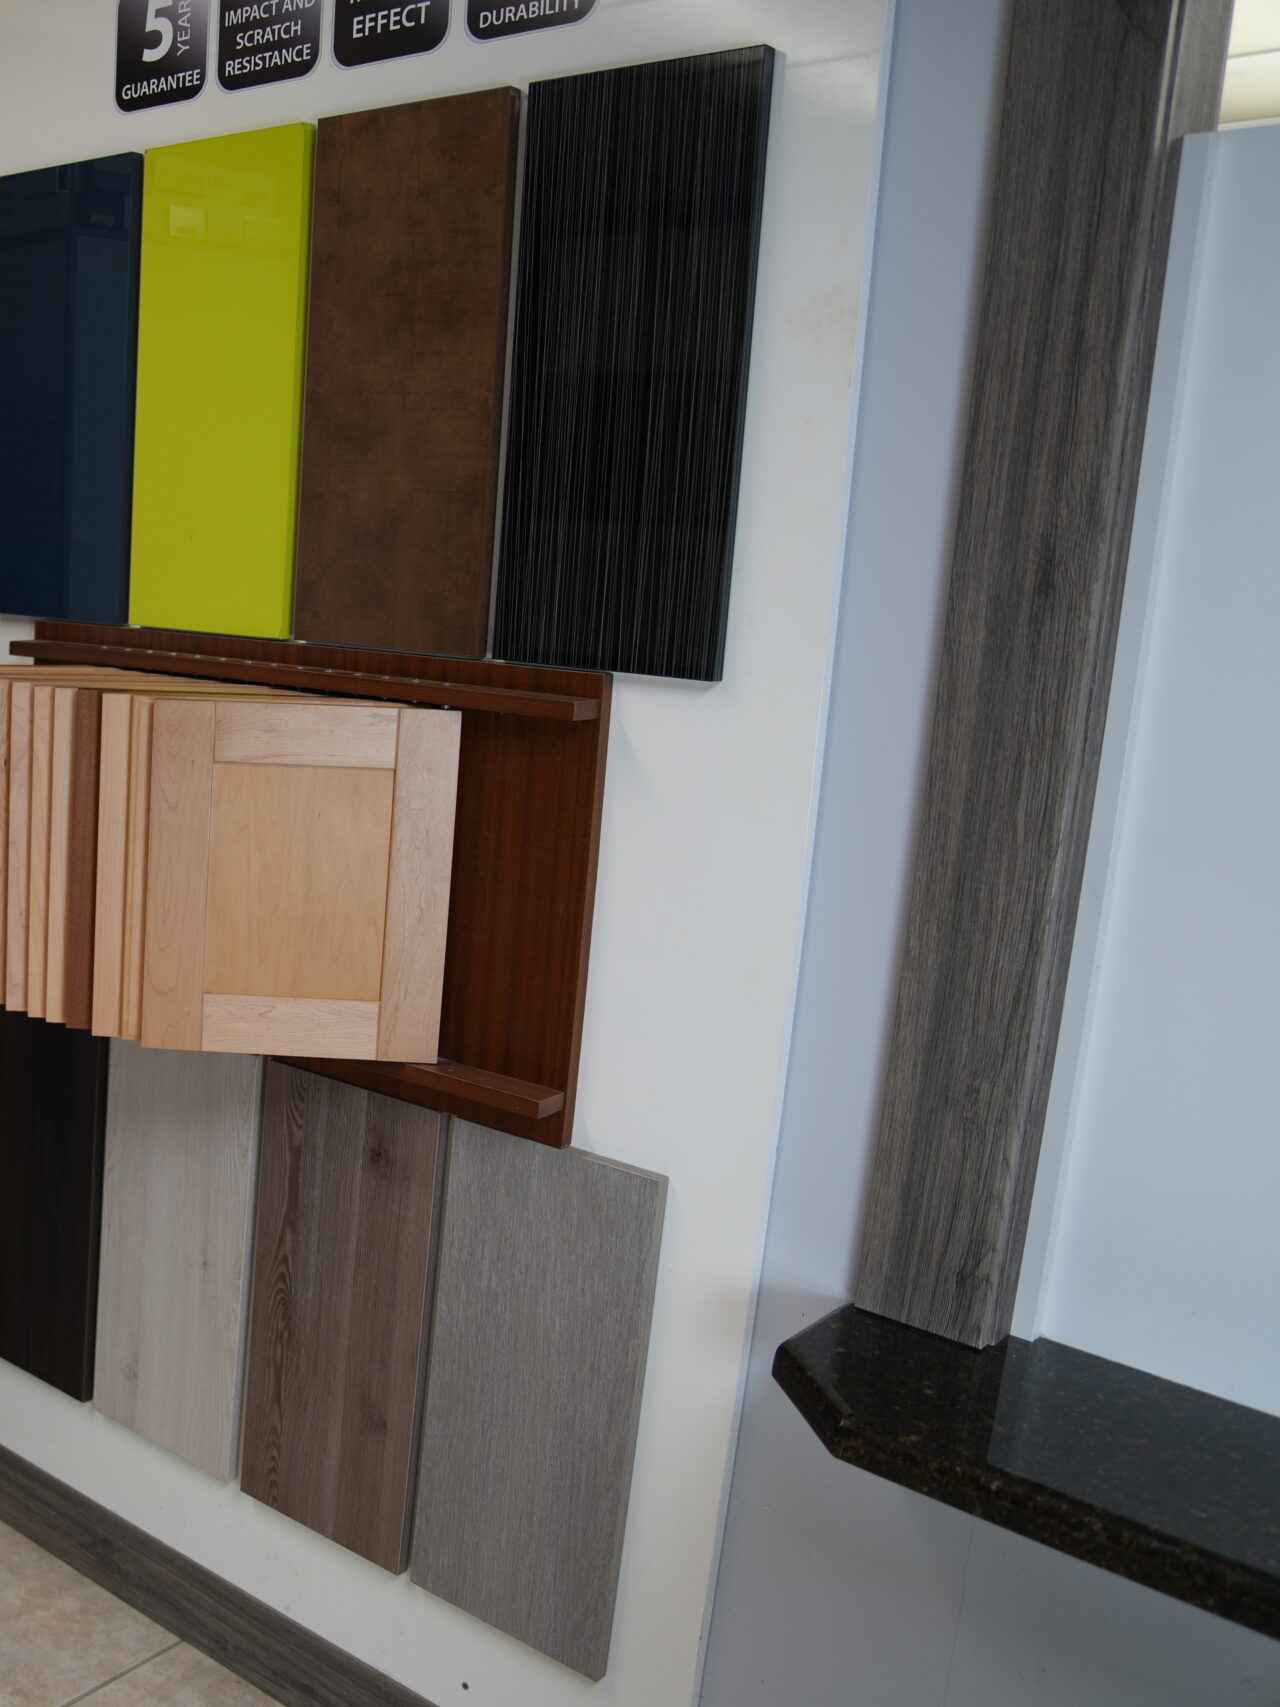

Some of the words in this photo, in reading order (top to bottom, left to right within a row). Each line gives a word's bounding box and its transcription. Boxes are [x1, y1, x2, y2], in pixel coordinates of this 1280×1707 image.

[225, 0, 279, 27] IMPACT
[353, 1, 431, 39] EFFECT
[142, 0, 174, 62] 5
[235, 19, 301, 49] SCRATCH
[225, 43, 311, 77] RESISTANCE
[122, 69, 201, 100] GUARANTEE
